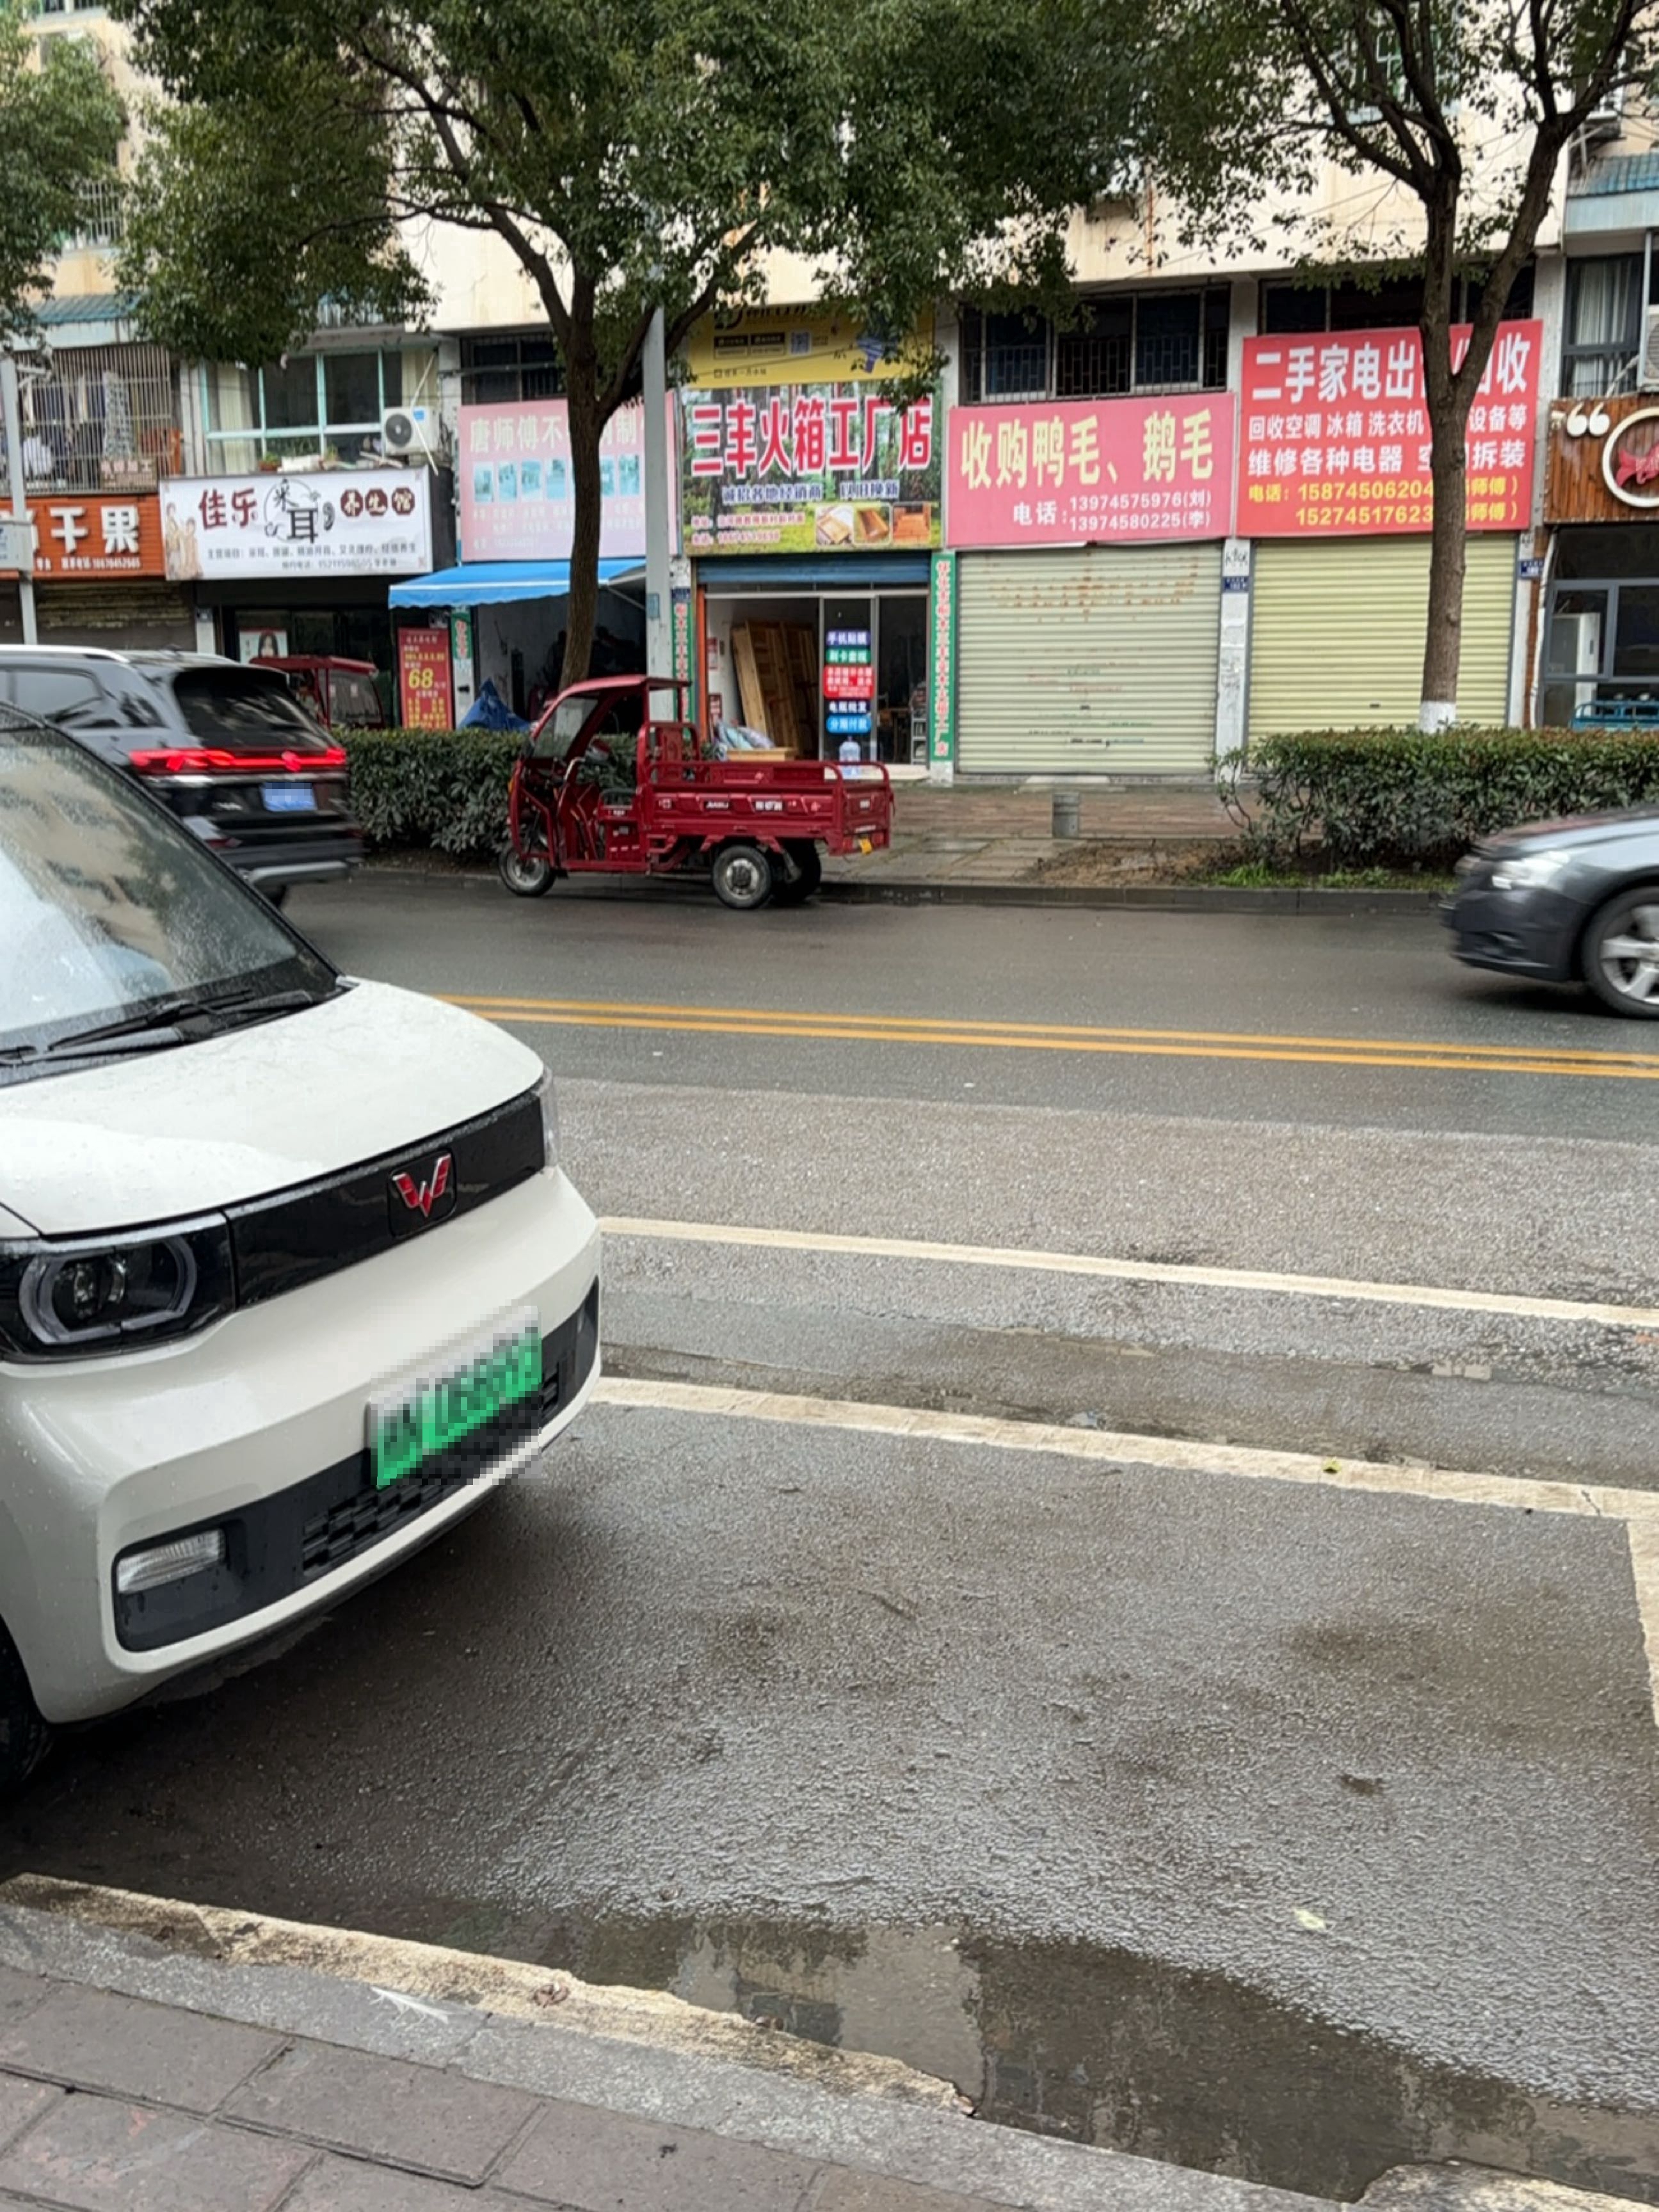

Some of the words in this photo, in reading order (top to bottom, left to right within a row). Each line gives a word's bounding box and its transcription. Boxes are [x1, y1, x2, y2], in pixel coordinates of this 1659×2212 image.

[691, 392, 933, 479] 三丰火箱工厂店
[1249, 413, 1322, 442] 回收空调
[1327, 411, 1363, 438] 冰箱
[1368, 408, 1424, 438] 洗衣机
[961, 414, 1118, 490] 收购鸭毛、
[1142, 408, 1213, 483] 鹅毛
[1248, 445, 1402, 476] 维修各种电器
[723, 483, 823, 504] 诚招各地经销商
[840, 479, 899, 499] 以旧换新
[198, 487, 257, 531] 佳乐
[409, 669, 433, 689] 68
